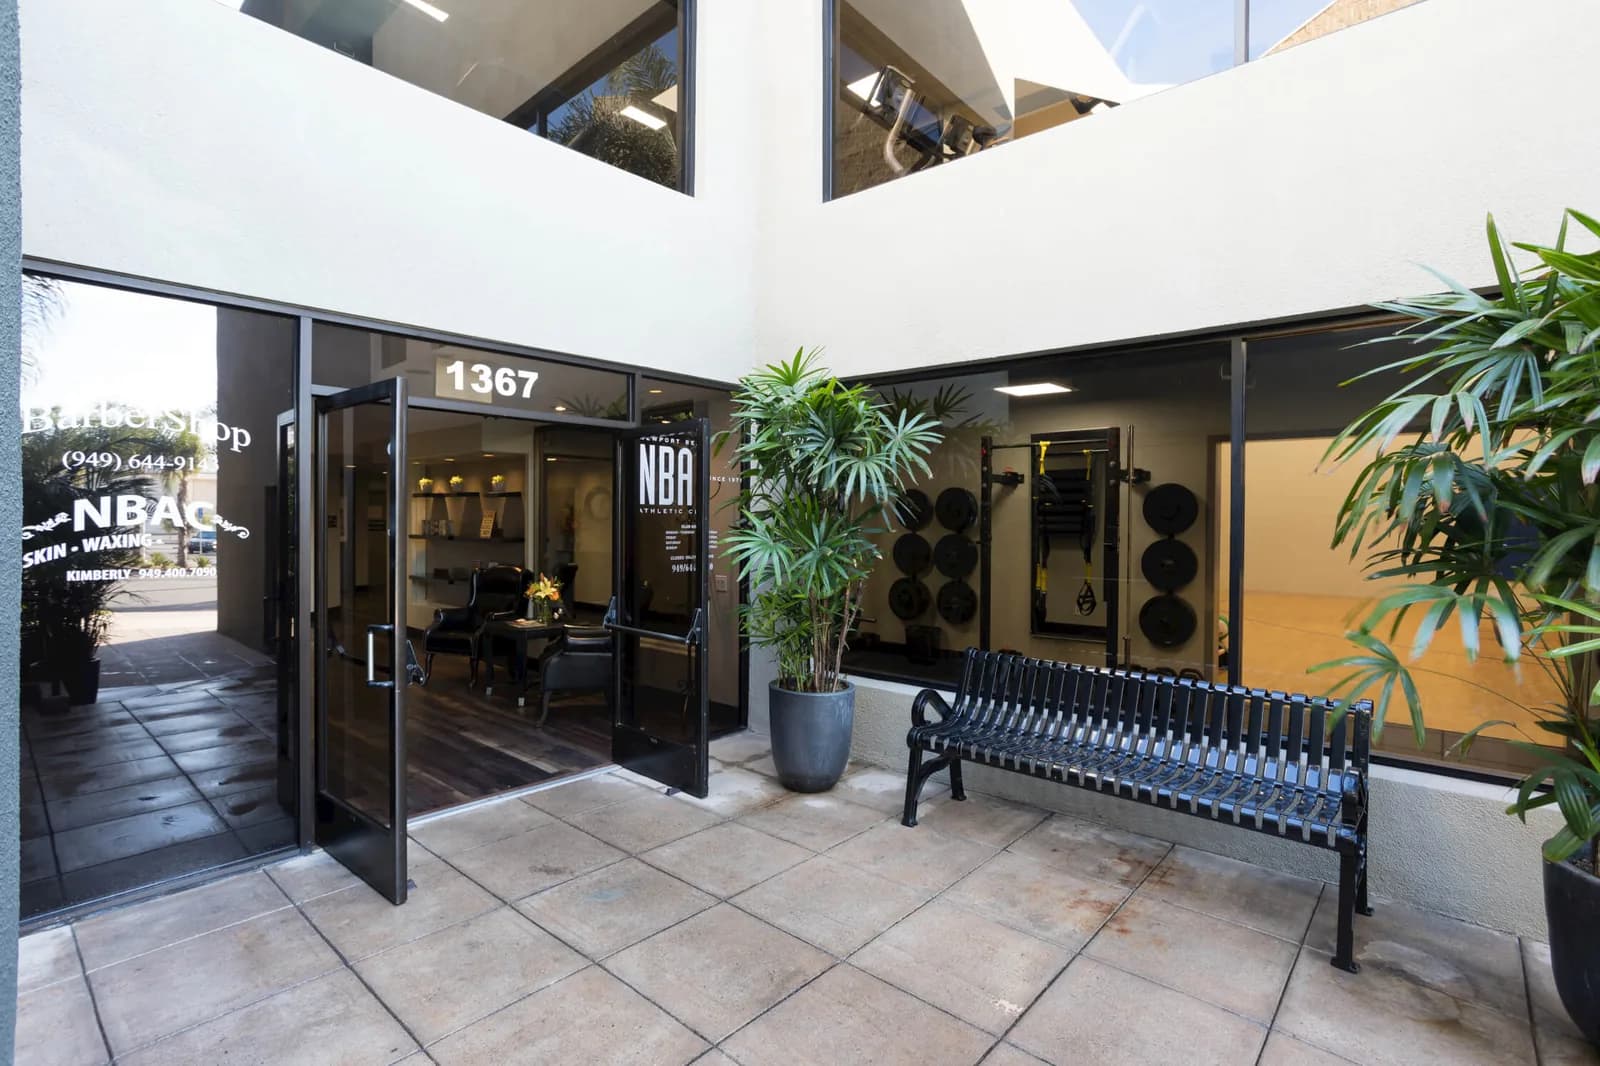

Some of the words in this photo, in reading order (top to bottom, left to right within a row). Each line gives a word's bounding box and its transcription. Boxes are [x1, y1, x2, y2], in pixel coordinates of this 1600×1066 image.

[446, 360, 539, 399] 1367
[62, 450, 122, 472] (949)
[73, 494, 216, 532] NBAC
[22, 542, 67, 569] SKIN
[82, 533, 152, 554] WAXING
[66, 568, 132, 582] KIMBERLY
